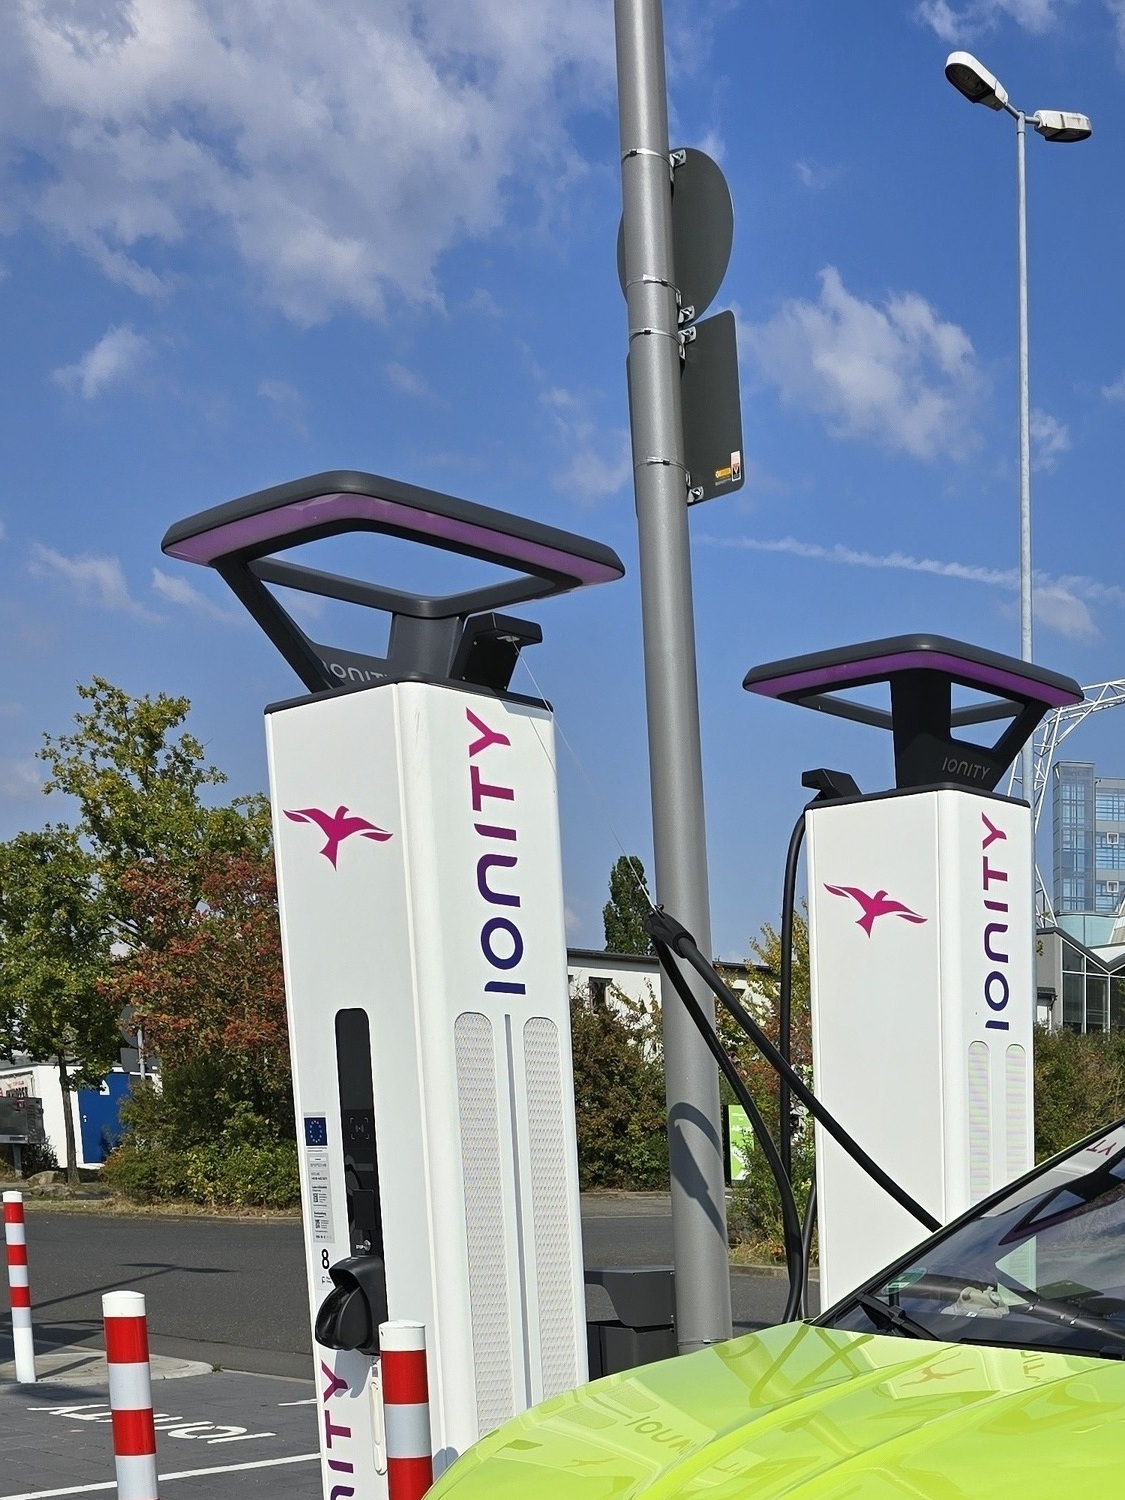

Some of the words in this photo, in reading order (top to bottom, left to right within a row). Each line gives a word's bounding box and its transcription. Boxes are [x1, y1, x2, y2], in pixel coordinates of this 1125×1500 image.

[942, 756, 991, 780] IONITY
[465, 706, 526, 995] IONITY
[981, 811, 1010, 1031] IONITY
[321, 1248, 330, 1270] 8
